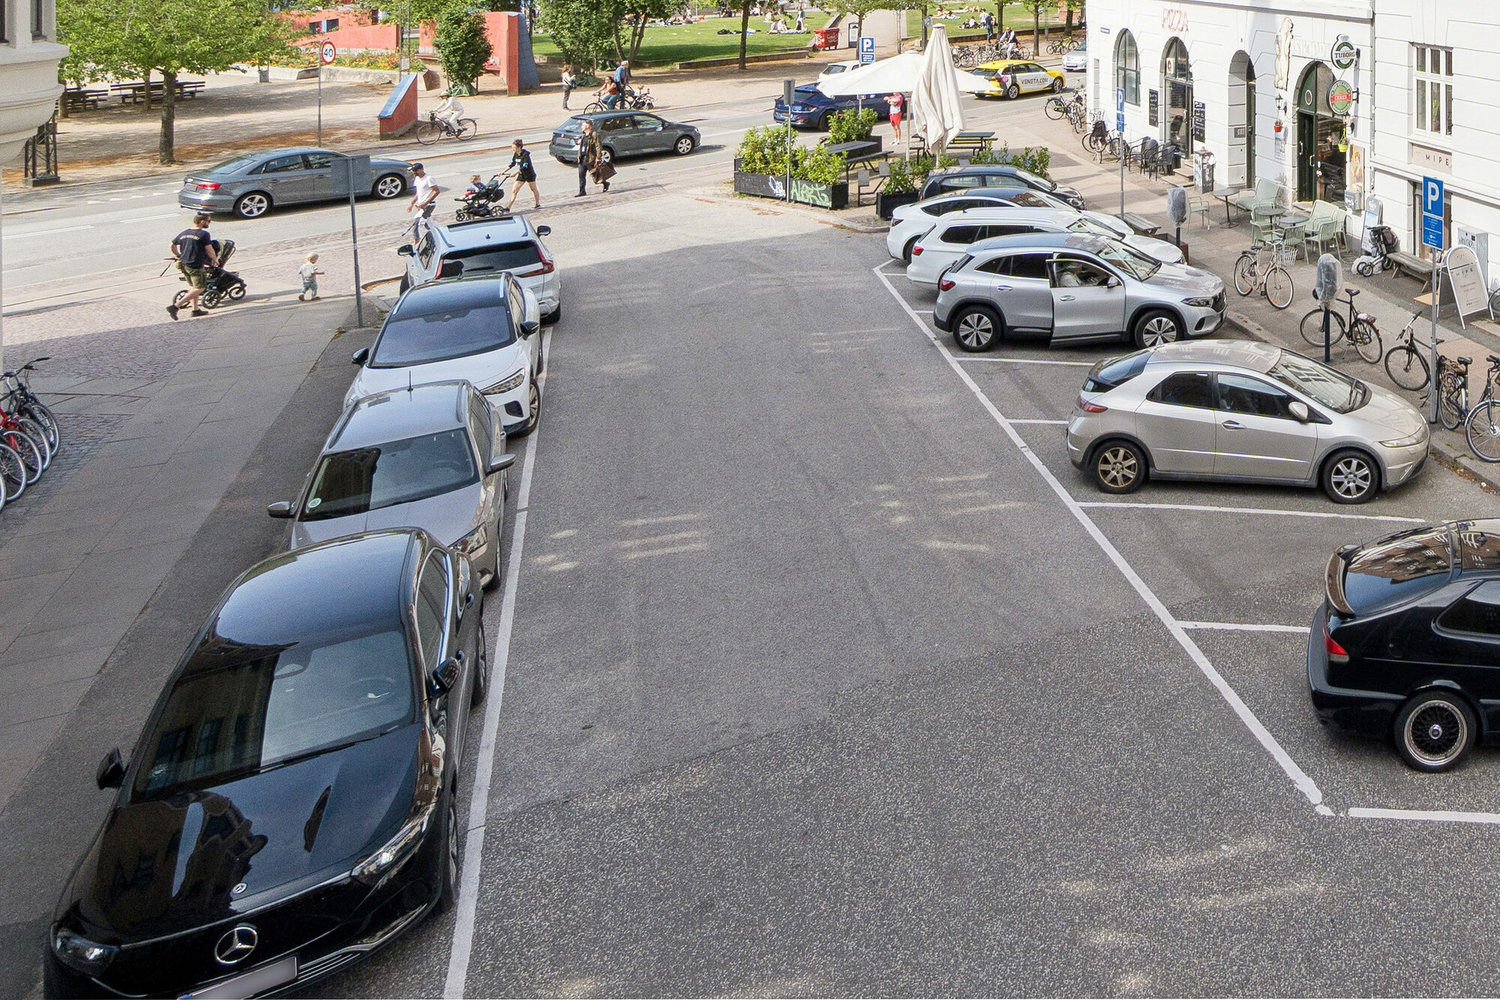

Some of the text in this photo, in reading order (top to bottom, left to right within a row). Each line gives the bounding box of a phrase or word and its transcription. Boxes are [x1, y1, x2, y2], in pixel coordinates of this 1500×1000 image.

[1162, 8, 1189, 32] PIZZA
[863, 38, 873, 52] P
[323, 48, 334, 58] 40
[1334, 51, 1356, 60] TUBORG
[1118, 90, 1123, 110] P
[1425, 153, 1449, 167] MIPE
[1427, 181, 1440, 210] P
